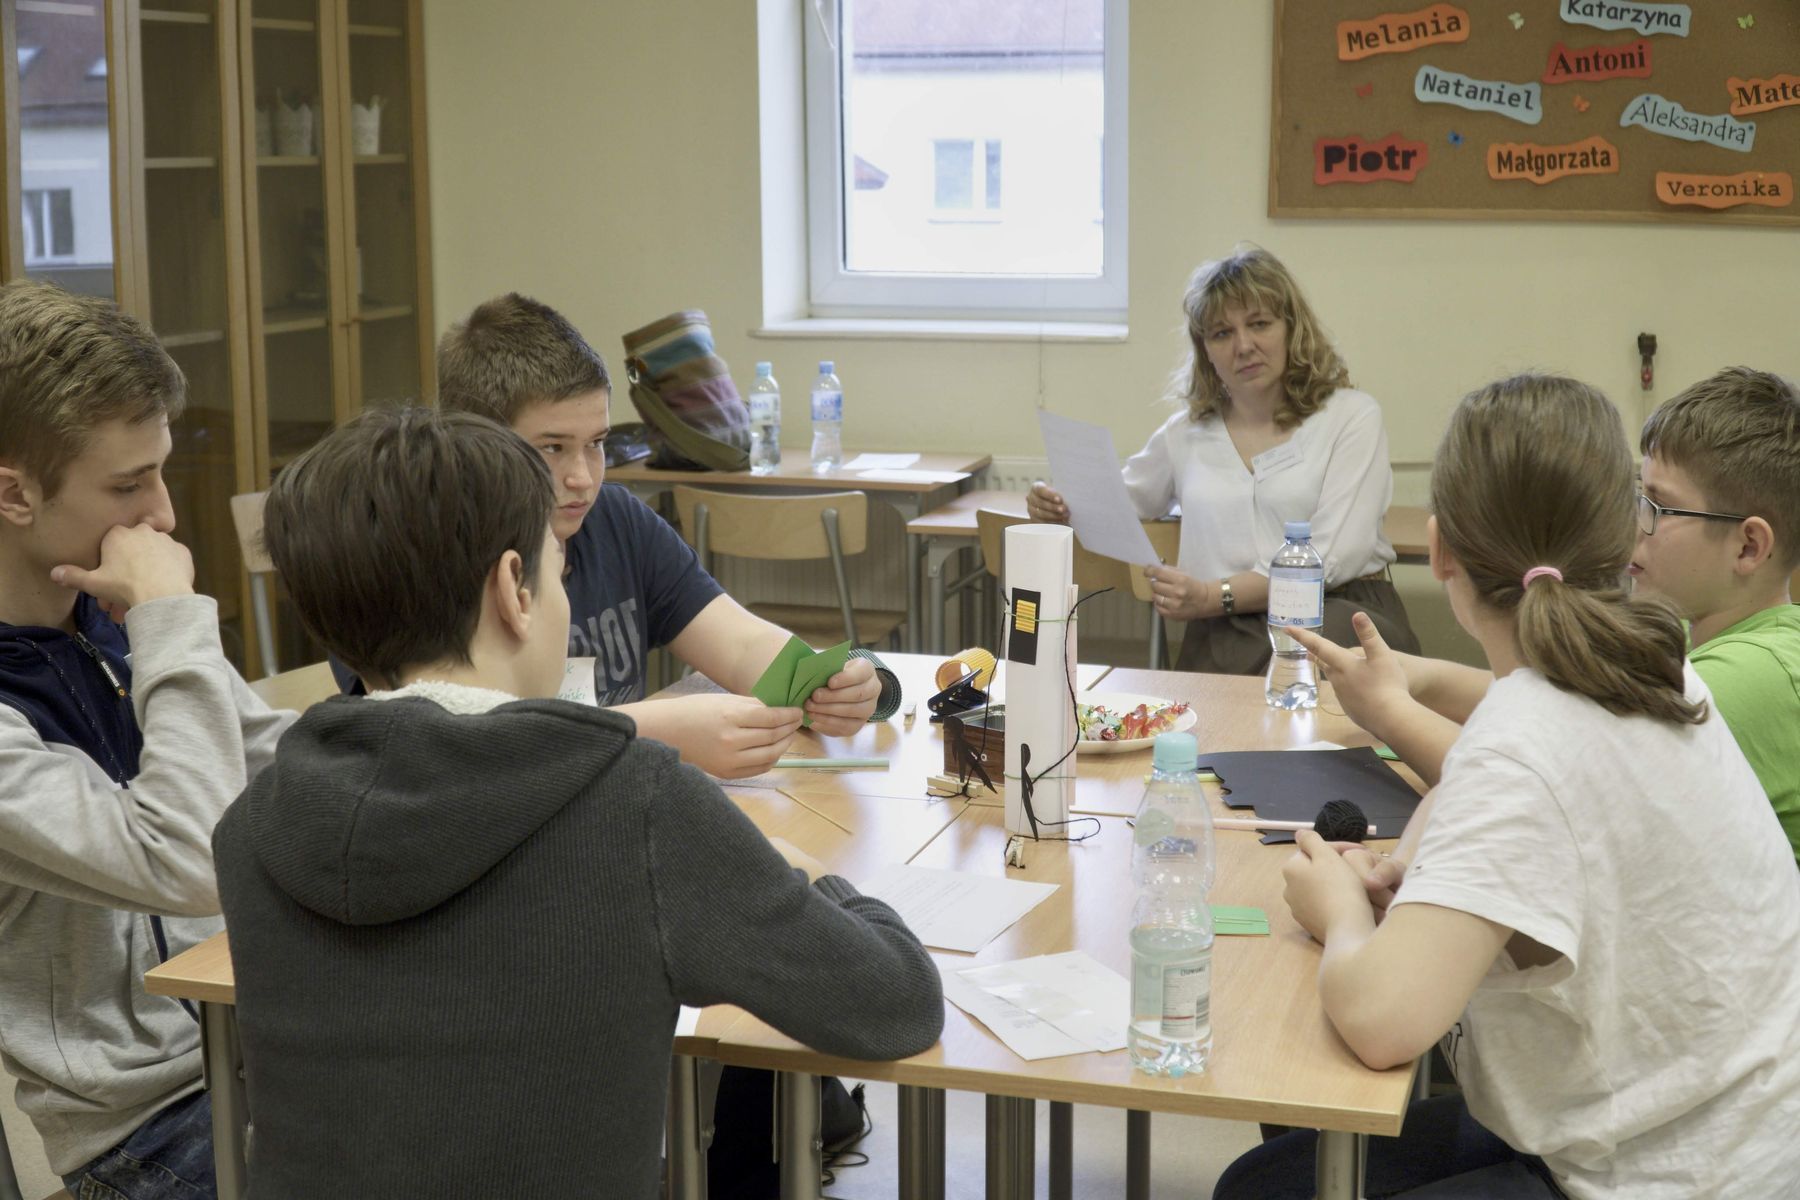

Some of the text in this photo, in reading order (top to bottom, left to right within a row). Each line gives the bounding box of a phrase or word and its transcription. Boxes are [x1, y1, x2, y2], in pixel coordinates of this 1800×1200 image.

[1567, 0, 1682, 28] Katarzyna
[1347, 11, 1462, 52] Melania
[1552, 45, 1647, 76] Antoni
[1422, 73, 1534, 110] Nataniel
[1630, 101, 1746, 145] Aleksandra
[1323, 144, 1418, 173] Piotr
[1497, 146, 1611, 176] Małgorzata
[1666, 180, 1781, 197] Veronika
